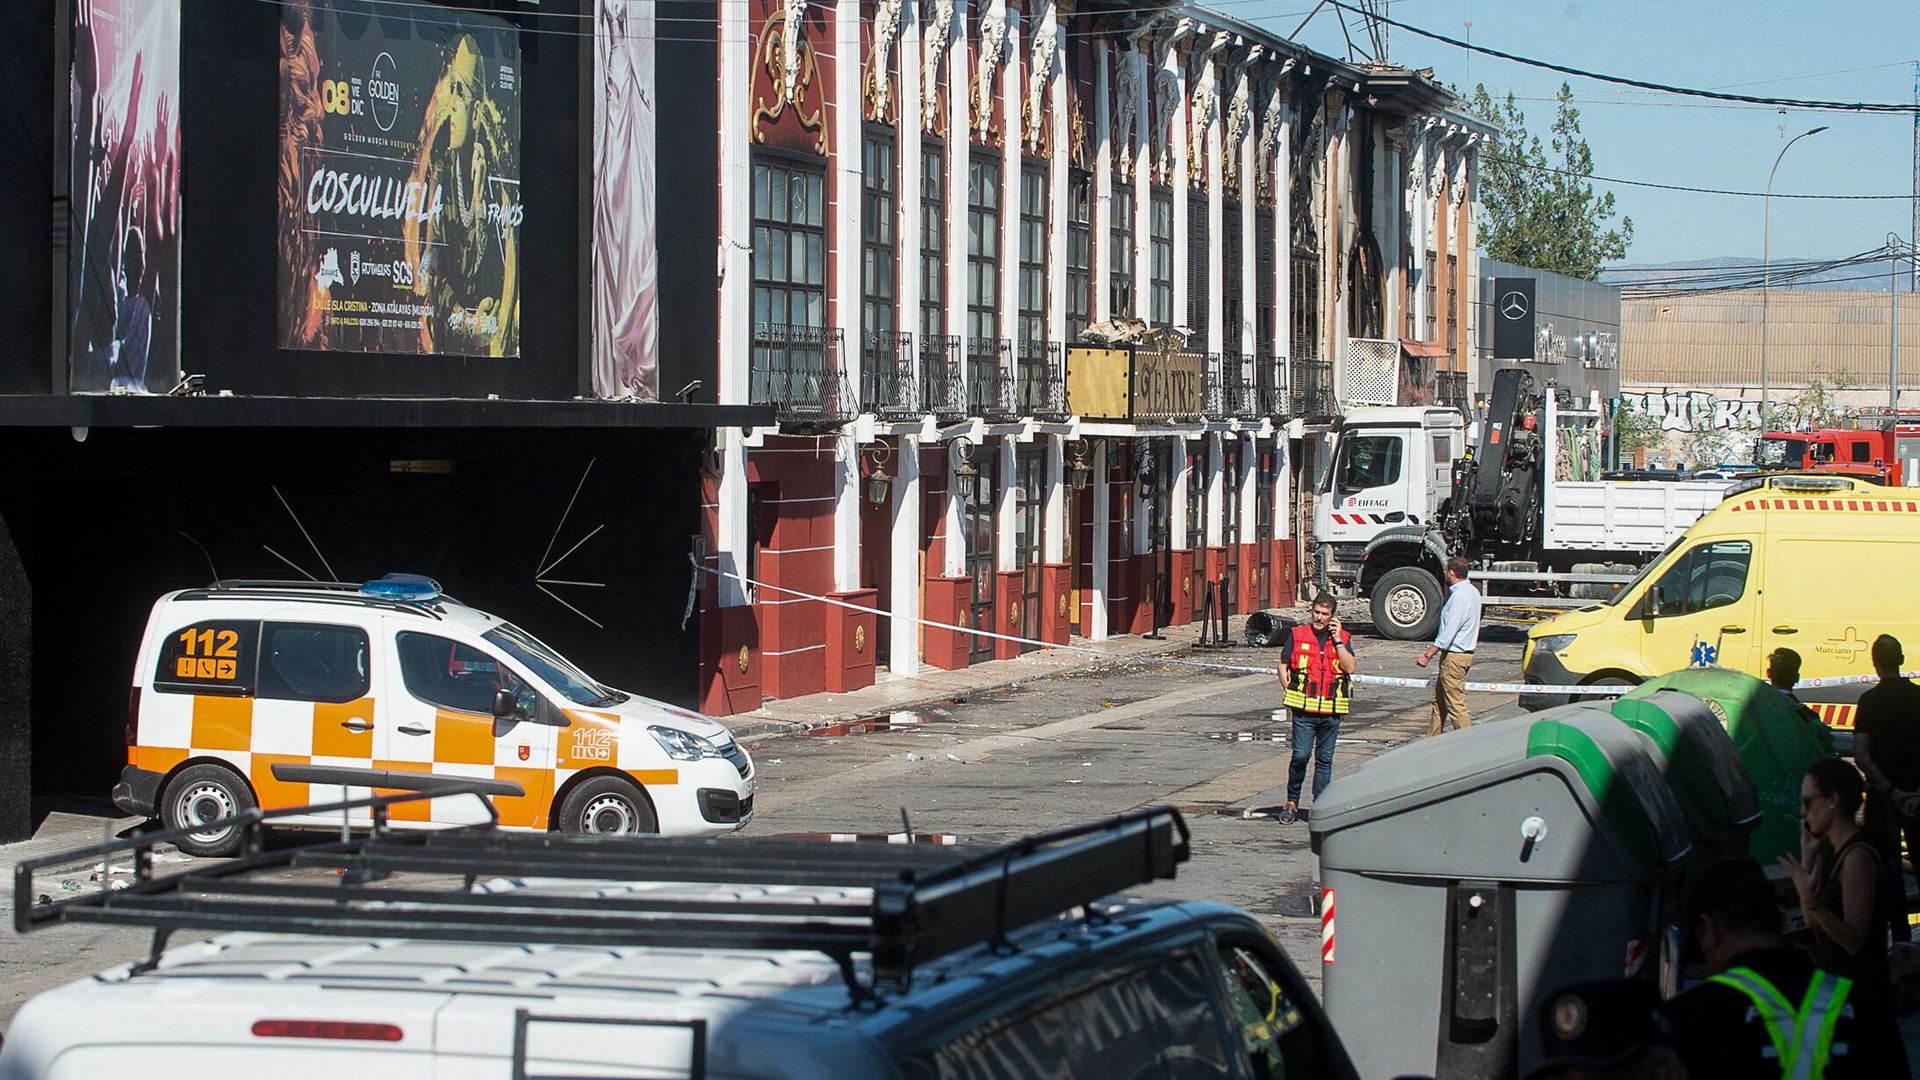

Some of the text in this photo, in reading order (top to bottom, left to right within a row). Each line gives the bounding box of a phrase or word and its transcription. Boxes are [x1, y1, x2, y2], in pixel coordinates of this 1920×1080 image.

[322, 79, 350, 116] 08
[368, 79, 399, 102] GOLDEN
[351, 99, 365, 116] DIC
[344, 133, 366, 143] GOLDEN
[307, 167, 443, 223] COSCULLUELA
[392, 260, 413, 285] SCS
[331, 300, 343, 312] ISLA
[344, 301, 369, 312] CRISTINA
[1141, 358, 1196, 414] TEATRE
[1358, 499, 1390, 507] EIFFAGE
[180, 628, 239, 657] 112
[1815, 646, 1852, 654] Murciano
[573, 727, 612, 747] 112
